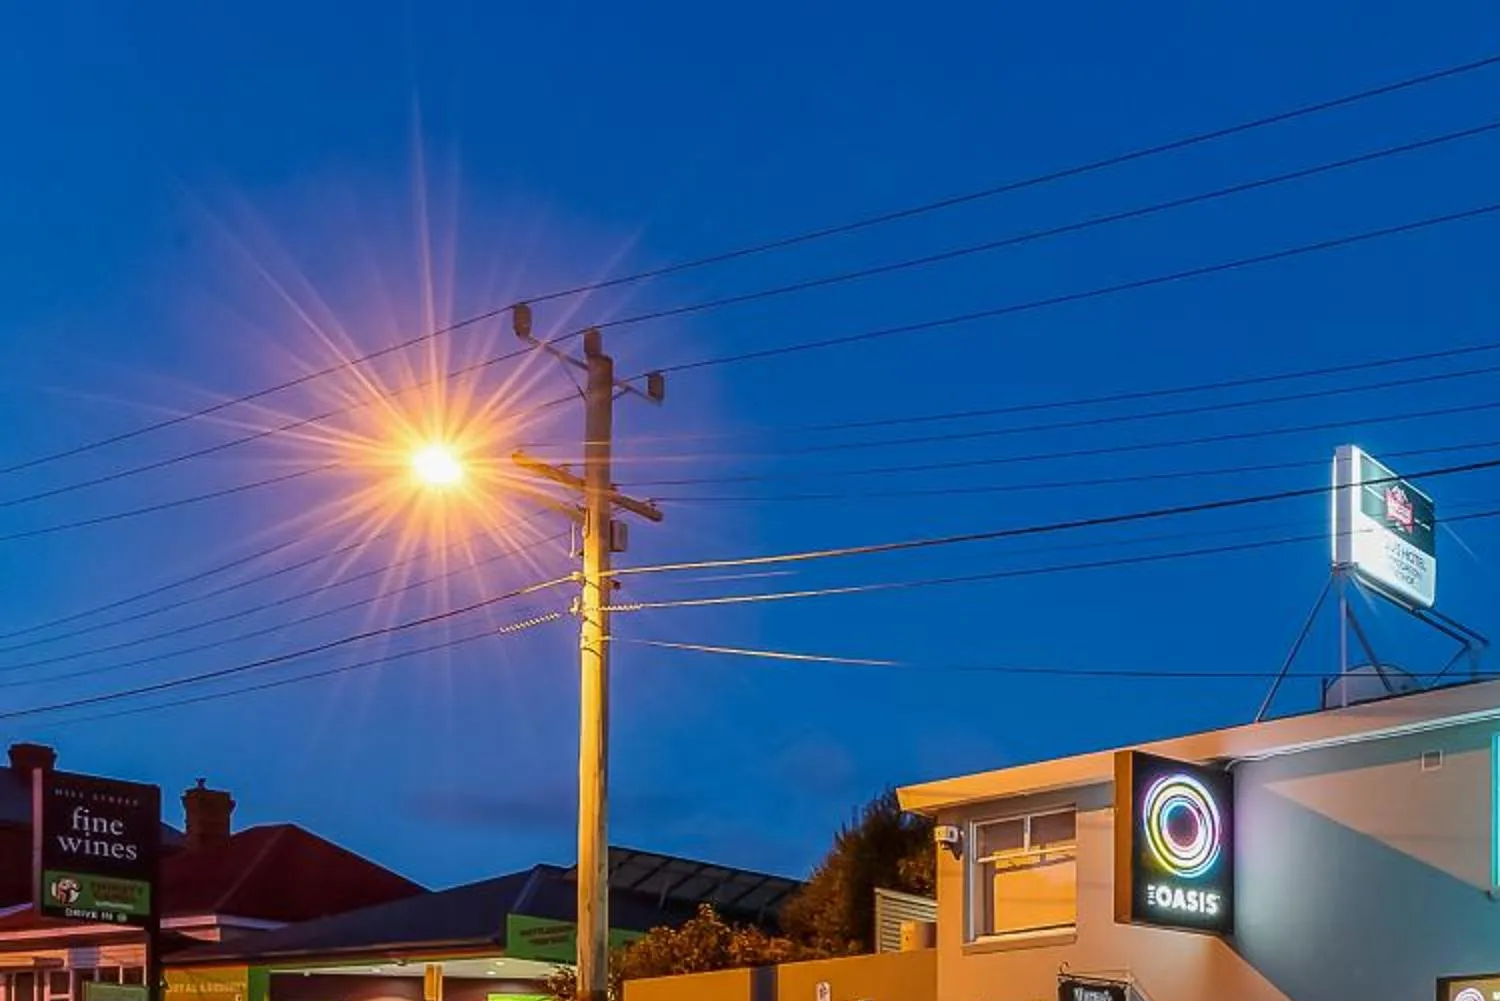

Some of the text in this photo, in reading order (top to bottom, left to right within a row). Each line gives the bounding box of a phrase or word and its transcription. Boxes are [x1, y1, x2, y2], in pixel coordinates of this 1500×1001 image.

[72, 805, 124, 836] fine
[57, 831, 138, 861] wines
[1156, 885, 1217, 916] OASIS
